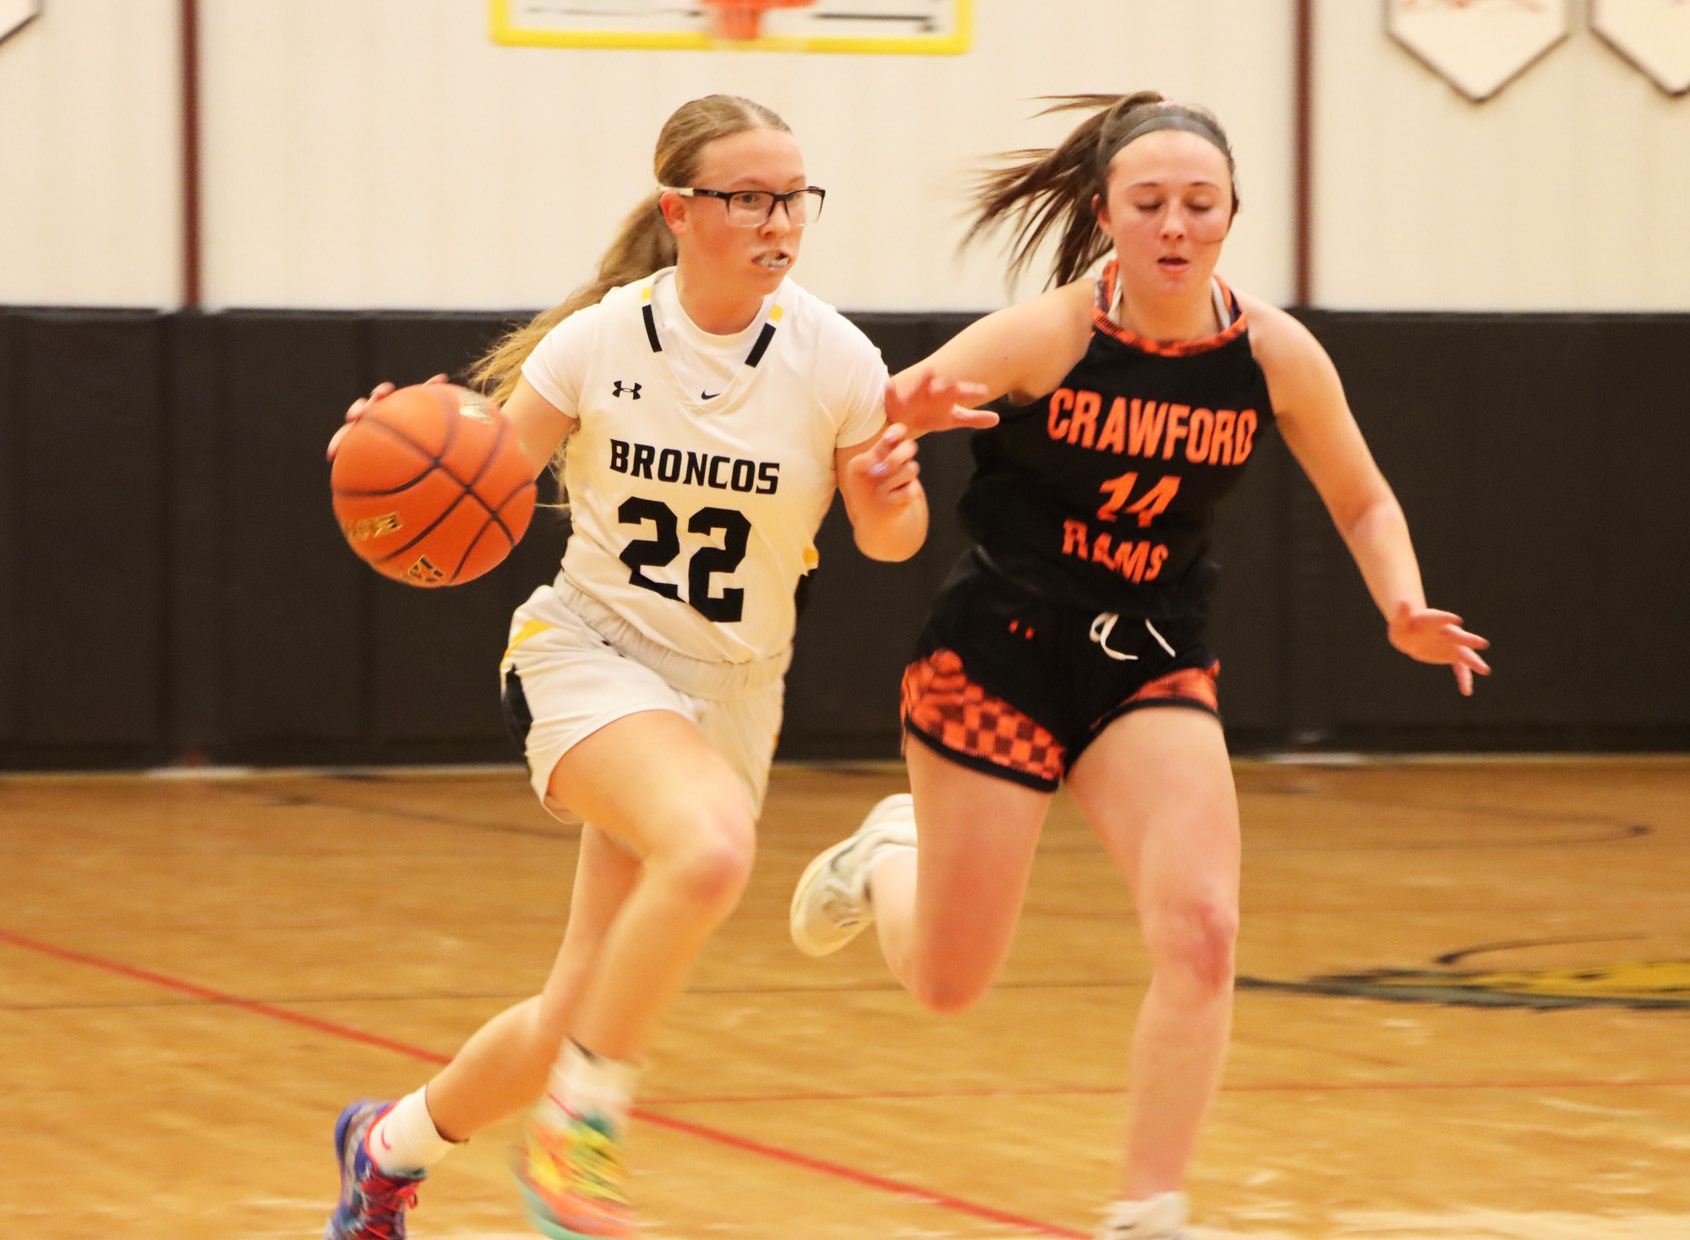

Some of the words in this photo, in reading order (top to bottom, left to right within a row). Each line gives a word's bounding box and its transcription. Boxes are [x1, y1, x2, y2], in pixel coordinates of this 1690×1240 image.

[1047, 388, 1257, 466] CRAWFORD
[610, 438, 780, 495] BRONCOS
[1097, 471, 1182, 528] 14
[618, 496, 752, 623] 22
[1062, 518, 1169, 584] RAMS
